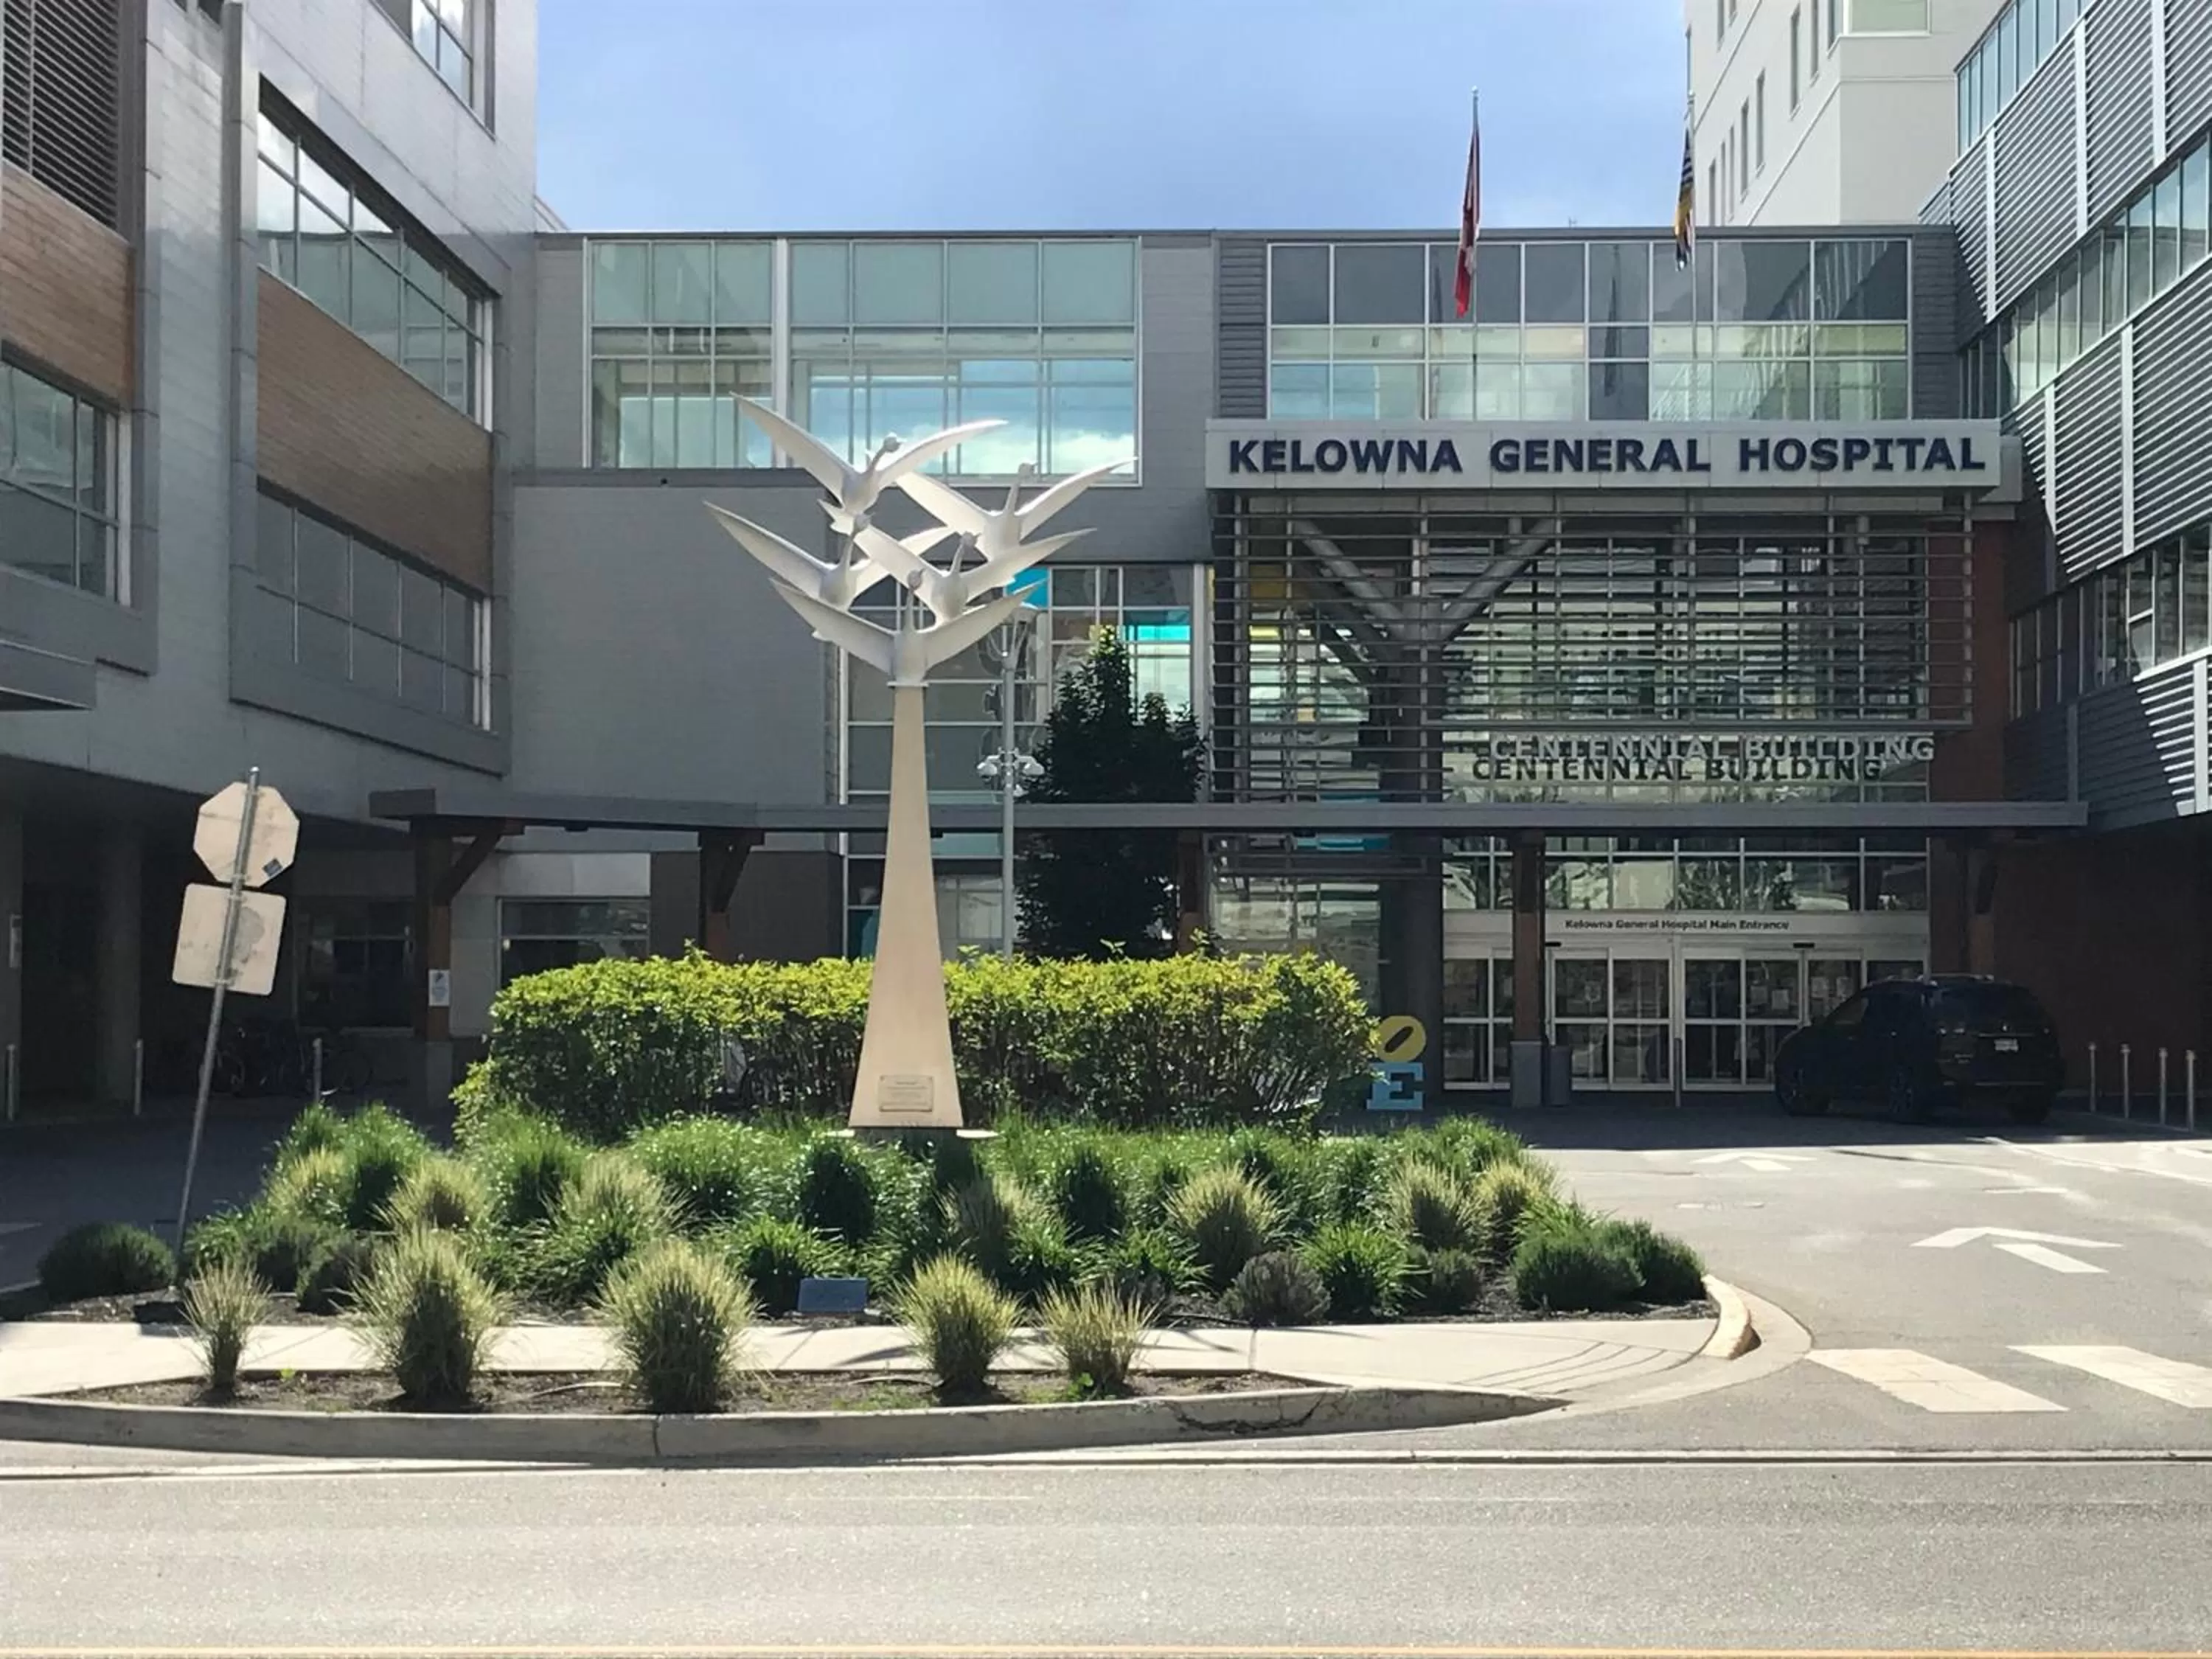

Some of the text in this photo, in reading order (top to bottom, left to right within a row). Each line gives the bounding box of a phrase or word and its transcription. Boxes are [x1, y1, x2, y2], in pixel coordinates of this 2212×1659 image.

[1229, 437, 1986, 473] KELOWNA GENERAL HOSPITAL
[1490, 737, 1935, 760] CENTENNIAL BUILDING
[1472, 757, 1882, 781] CENTENNIAL BUILDING
[1565, 919, 1790, 931] Kelowna General Hospital Main Entrance
